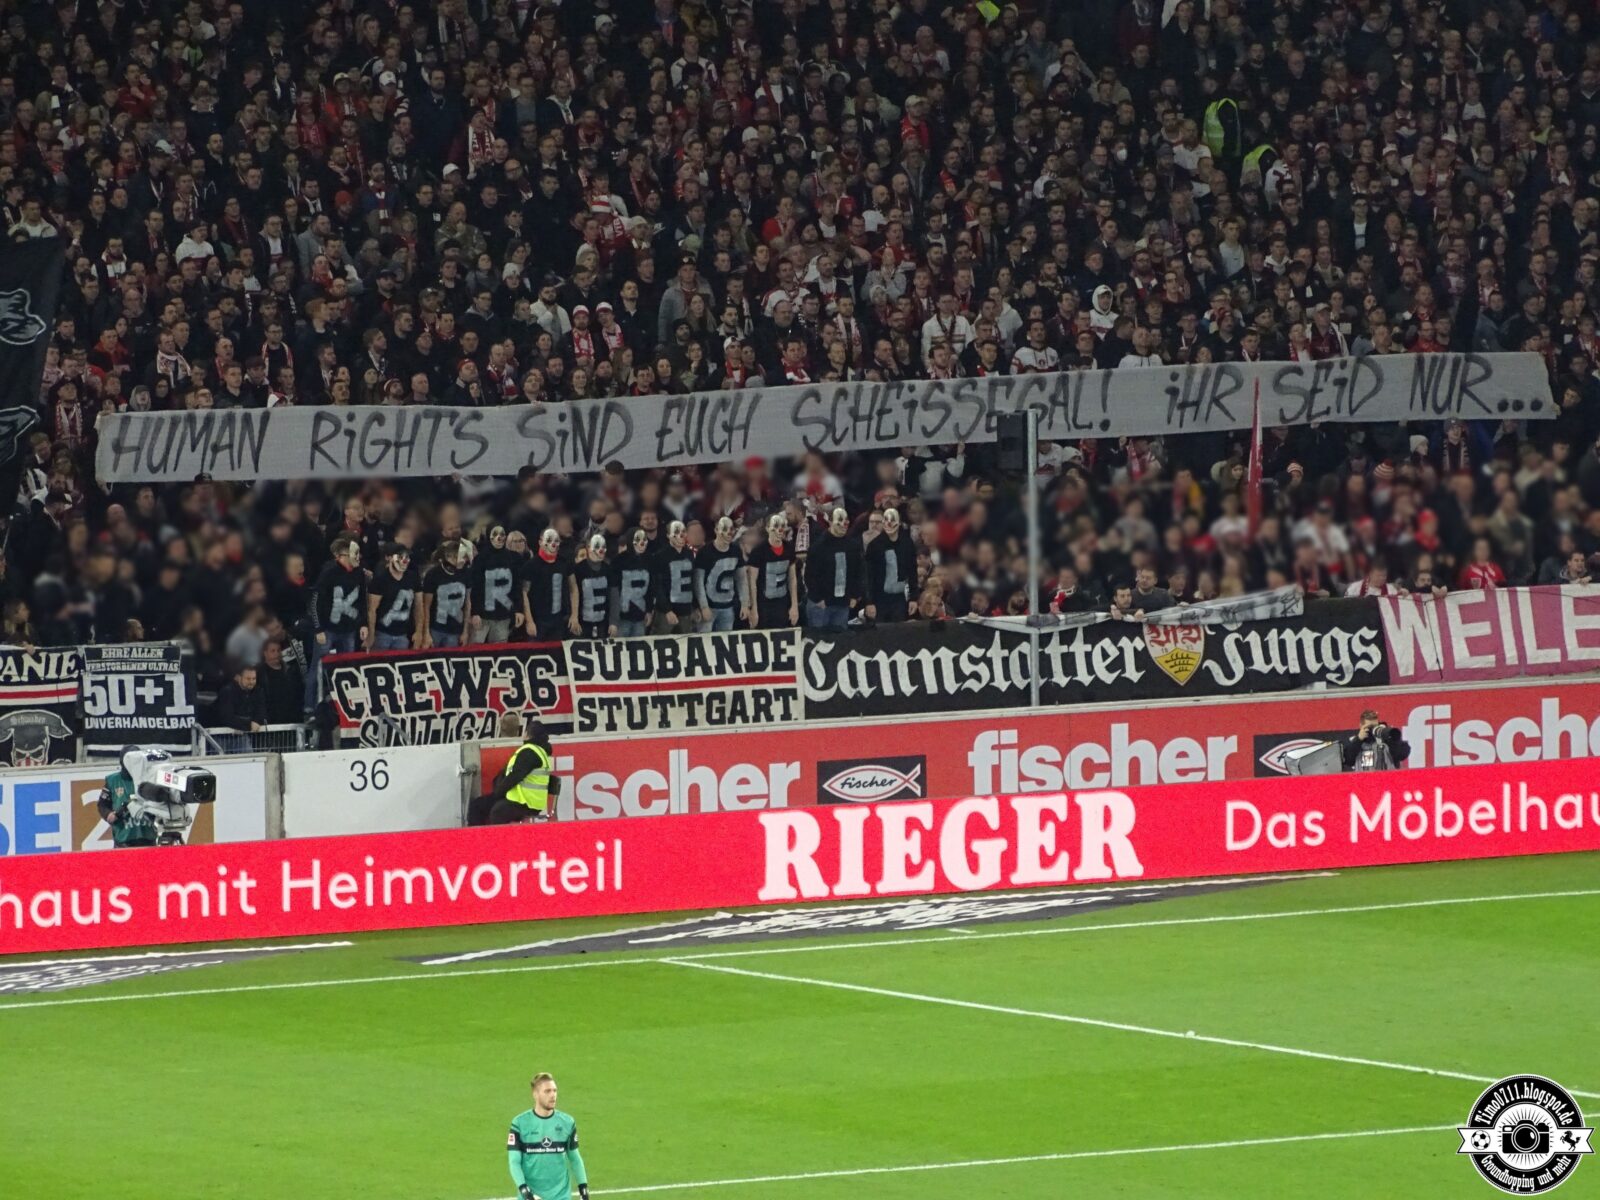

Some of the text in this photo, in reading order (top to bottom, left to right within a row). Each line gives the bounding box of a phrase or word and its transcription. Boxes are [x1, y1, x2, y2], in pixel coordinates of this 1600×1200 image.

[112, 410, 271, 474] HUMAN
[655, 391, 764, 463] EUCH
[1377, 584, 1600, 678] WEILE
[0, 650, 79, 683] ANIE
[101, 647, 164, 659] EHRE ALLEN
[148, 662, 179, 672] ULTRAS
[569, 630, 798, 682] SÜDBANDE
[801, 621, 1382, 702] Cannstatter Jungs
[82, 673, 195, 716] 50+1
[577, 687, 799, 733] STUTTGART
[85, 716, 196, 730] UNVERHANDELBAR
[359, 710, 541, 749] STUTTGAT
[349, 758, 390, 792] 36
[548, 697, 1600, 822] ischer fischer fisch
[840, 775, 898, 790] fischer
[158, 864, 258, 921] mit
[281, 838, 624, 913] Heimvorteil
[757, 790, 1145, 901] RIEGER
[1225, 800, 1327, 852] Das
